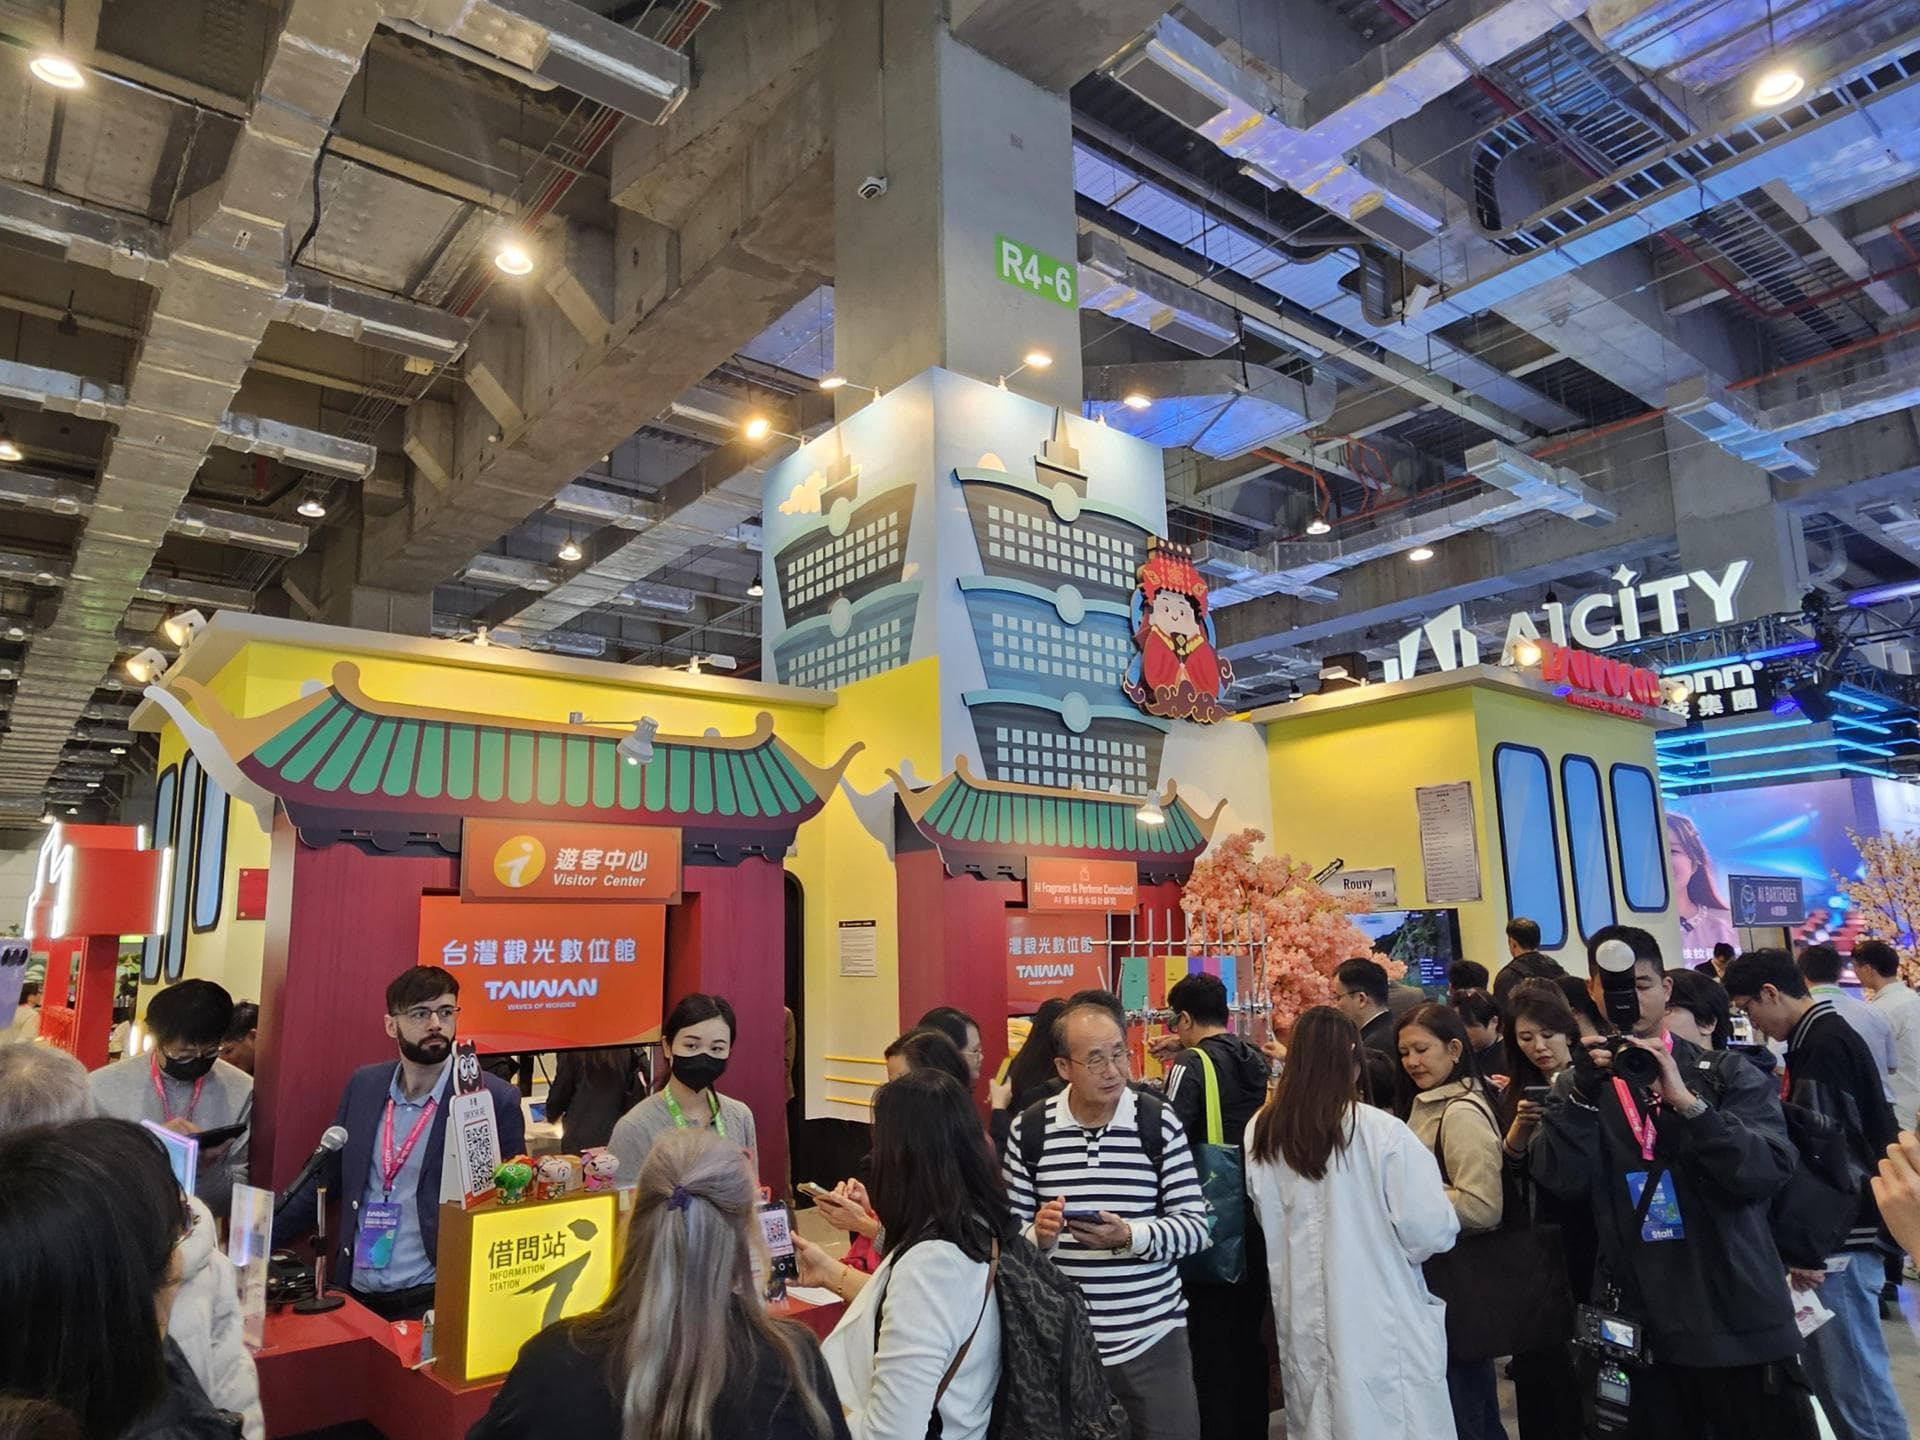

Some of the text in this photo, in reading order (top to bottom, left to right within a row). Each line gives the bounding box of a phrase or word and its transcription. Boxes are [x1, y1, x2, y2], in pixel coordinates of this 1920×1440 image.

[1002, 240, 1072, 302] R4-6
[554, 847, 648, 872] 遊客中心
[553, 873, 647, 888] Visitor Center
[1343, 878, 1373, 891] Rouvy
[442, 938, 636, 966] 台灣觀光數位館
[1016, 963, 1075, 979] TAIWAN
[484, 978, 598, 1001] TAIWAN
[507, 1001, 577, 1011] WAVES OF WONDER
[1651, 1228, 1674, 1239] Staff
[488, 1231, 567, 1270] 借問站
[489, 1263, 546, 1281] INFORMATION
[489, 1280, 520, 1293] STATION
